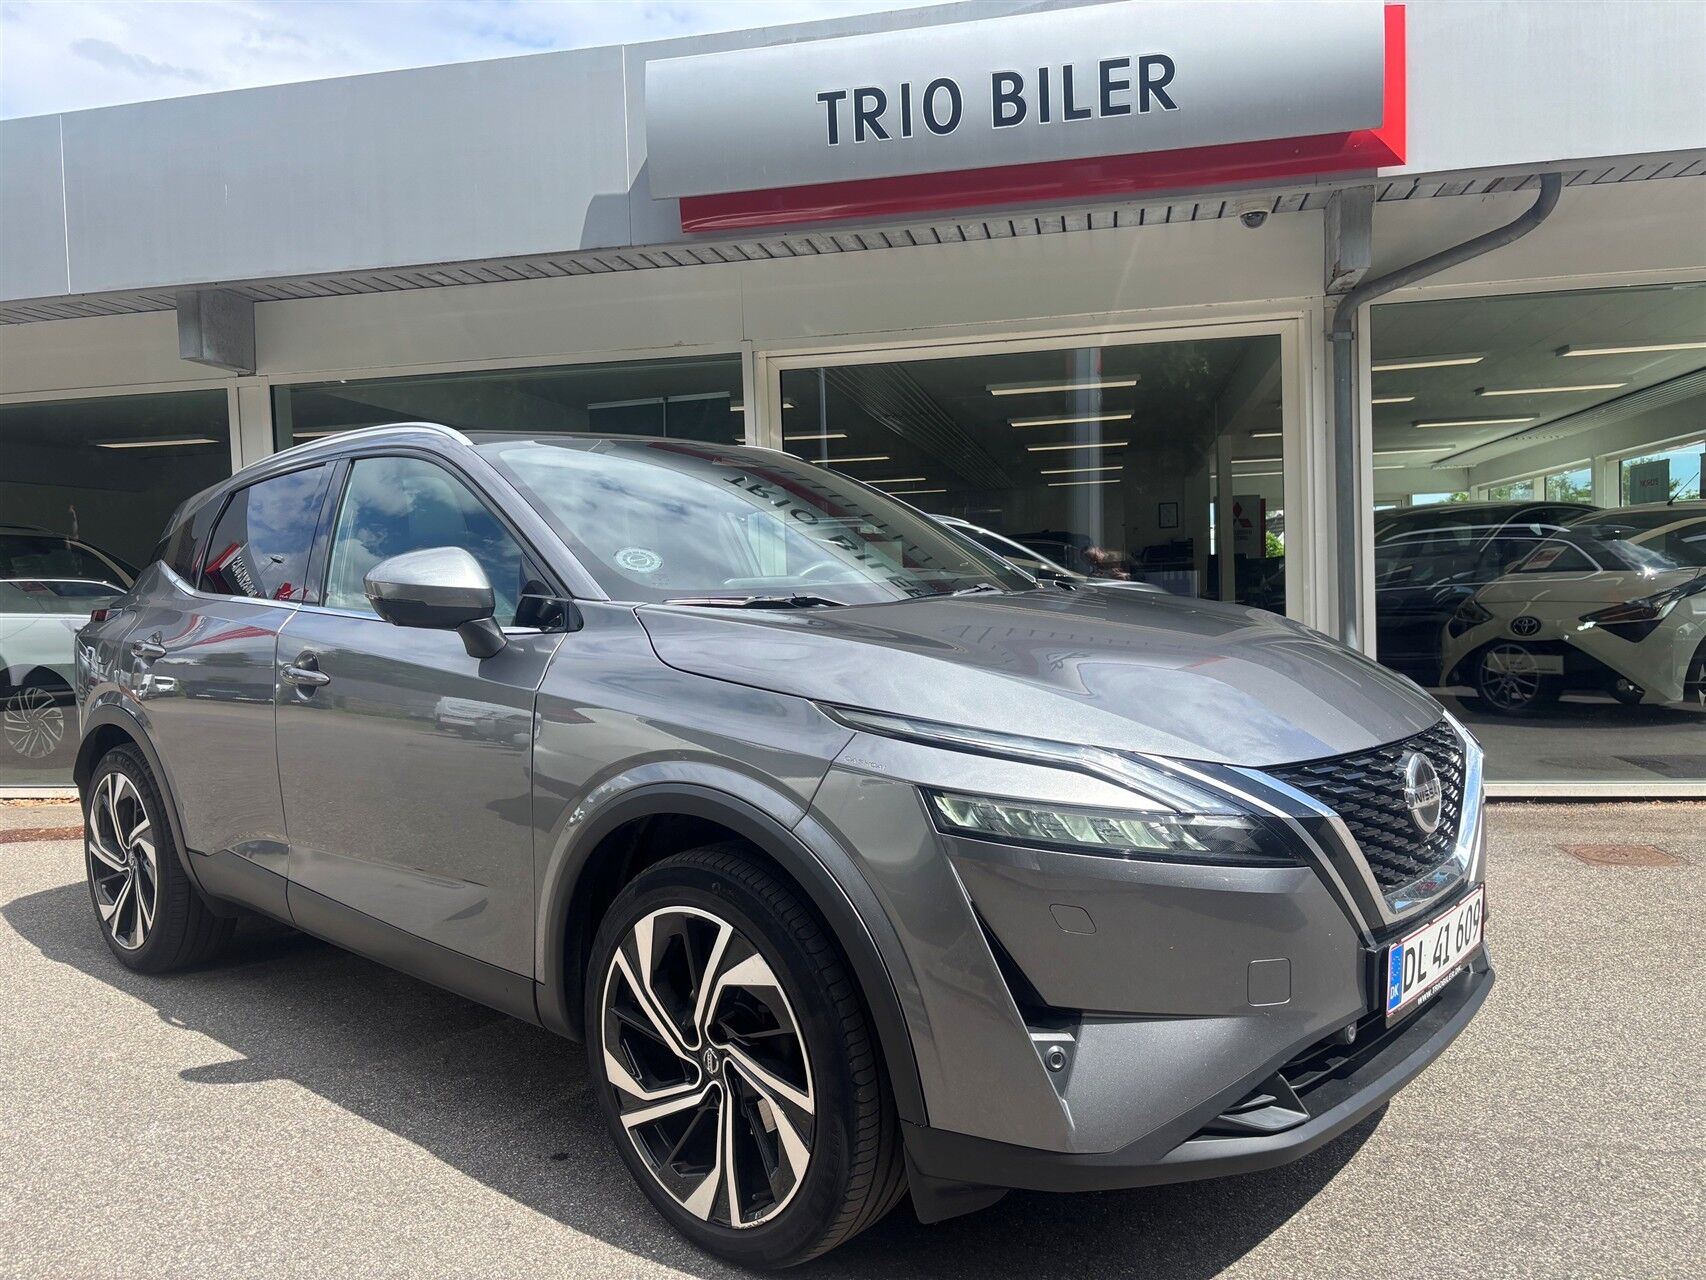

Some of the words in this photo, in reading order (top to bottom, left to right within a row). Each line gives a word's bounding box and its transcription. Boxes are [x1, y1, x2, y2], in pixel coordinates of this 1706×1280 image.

[815, 76, 963, 146] TRIO
[990, 53, 1180, 129] BILER
[1414, 782, 1440, 804] NISSA
[1403, 940, 1427, 993] DL
[1432, 922, 1450, 969] 41
[1456, 898, 1481, 953] 609
[1390, 983, 1400, 1000] DK
